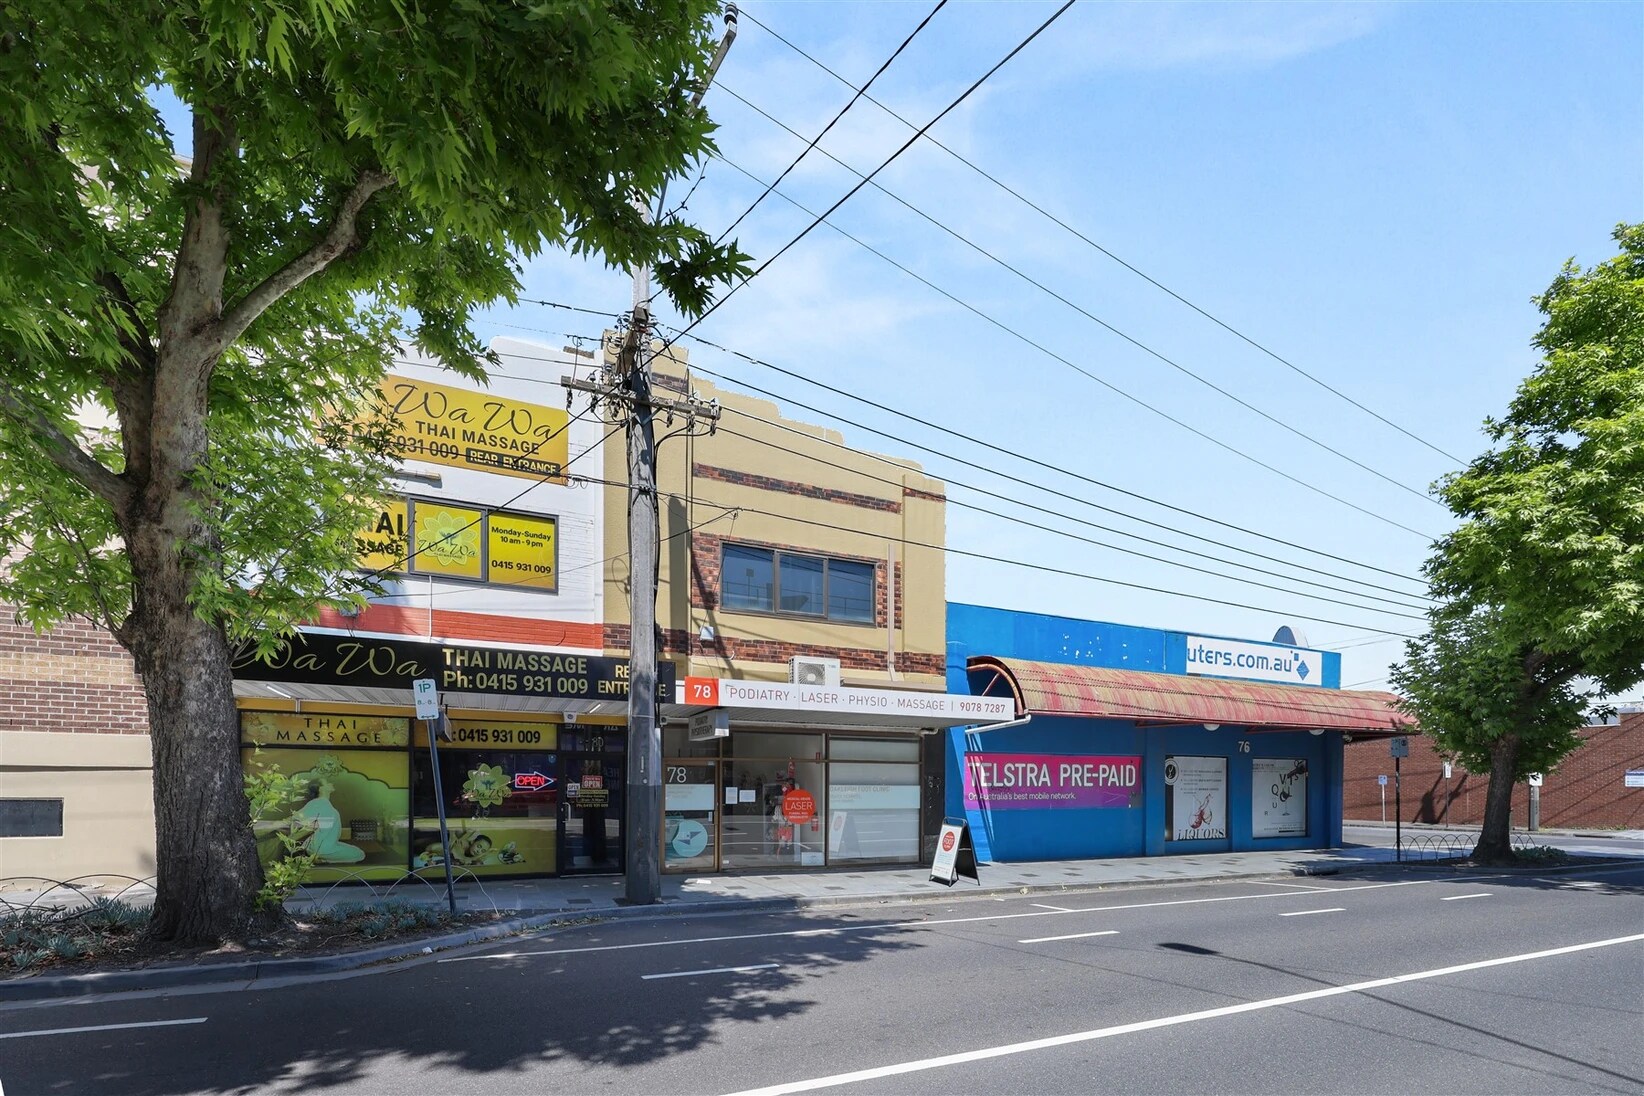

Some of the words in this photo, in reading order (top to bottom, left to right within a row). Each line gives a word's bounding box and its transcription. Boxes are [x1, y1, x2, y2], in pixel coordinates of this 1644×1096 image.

[394, 384, 476, 424] Wa
[483, 402, 554, 439] Wa
[415, 420, 456, 440] THAI
[462, 429, 540, 455] MASSAGE
[397, 435, 424, 454] 931
[429, 440, 459, 459] 009
[470, 450, 498, 466] REAR
[502, 456, 557, 475] ENTRANCE
[491, 526, 552, 542] Monday-Sunday
[491, 560, 513, 569] 0415
[517, 562, 532, 571] 931
[534, 564, 551, 573] 009
[336, 642, 426, 677] Wa
[442, 648, 489, 668] THAI
[497, 652, 587, 675] MASSAGE
[1188, 645, 1292, 673] uters.com.au
[615, 664, 630, 679] RE
[418, 683, 431, 693] 1P
[443, 670, 473, 689] Ph:
[476, 673, 518, 691] 0415
[523, 675, 552, 693] 931
[557, 677, 589, 694] 009
[693, 685, 711, 698] 78
[730, 687, 790, 702] PODIATRY
[801, 691, 838, 704] LASER
[848, 695, 888, 707] PHYSIO
[897, 698, 945, 711] MASSAGE
[960, 701, 982, 713] 9078
[985, 703, 1006, 714] 7287
[304, 718, 356, 730] THAI
[277, 731, 381, 744] MASSAGE
[459, 728, 488, 742] 0415
[492, 730, 513, 743] 931
[518, 730, 541, 743] 009
[1238, 741, 1250, 753] 76
[517, 775, 545, 786] OPEN
[667, 767, 686, 783] 78
[967, 763, 1051, 787] TELSTRA
[1060, 764, 1137, 787] PRE-PAID
[1014, 792, 1028, 800] best
[1029, 791, 1050, 800] mobile
[785, 801, 813, 811] LASER
